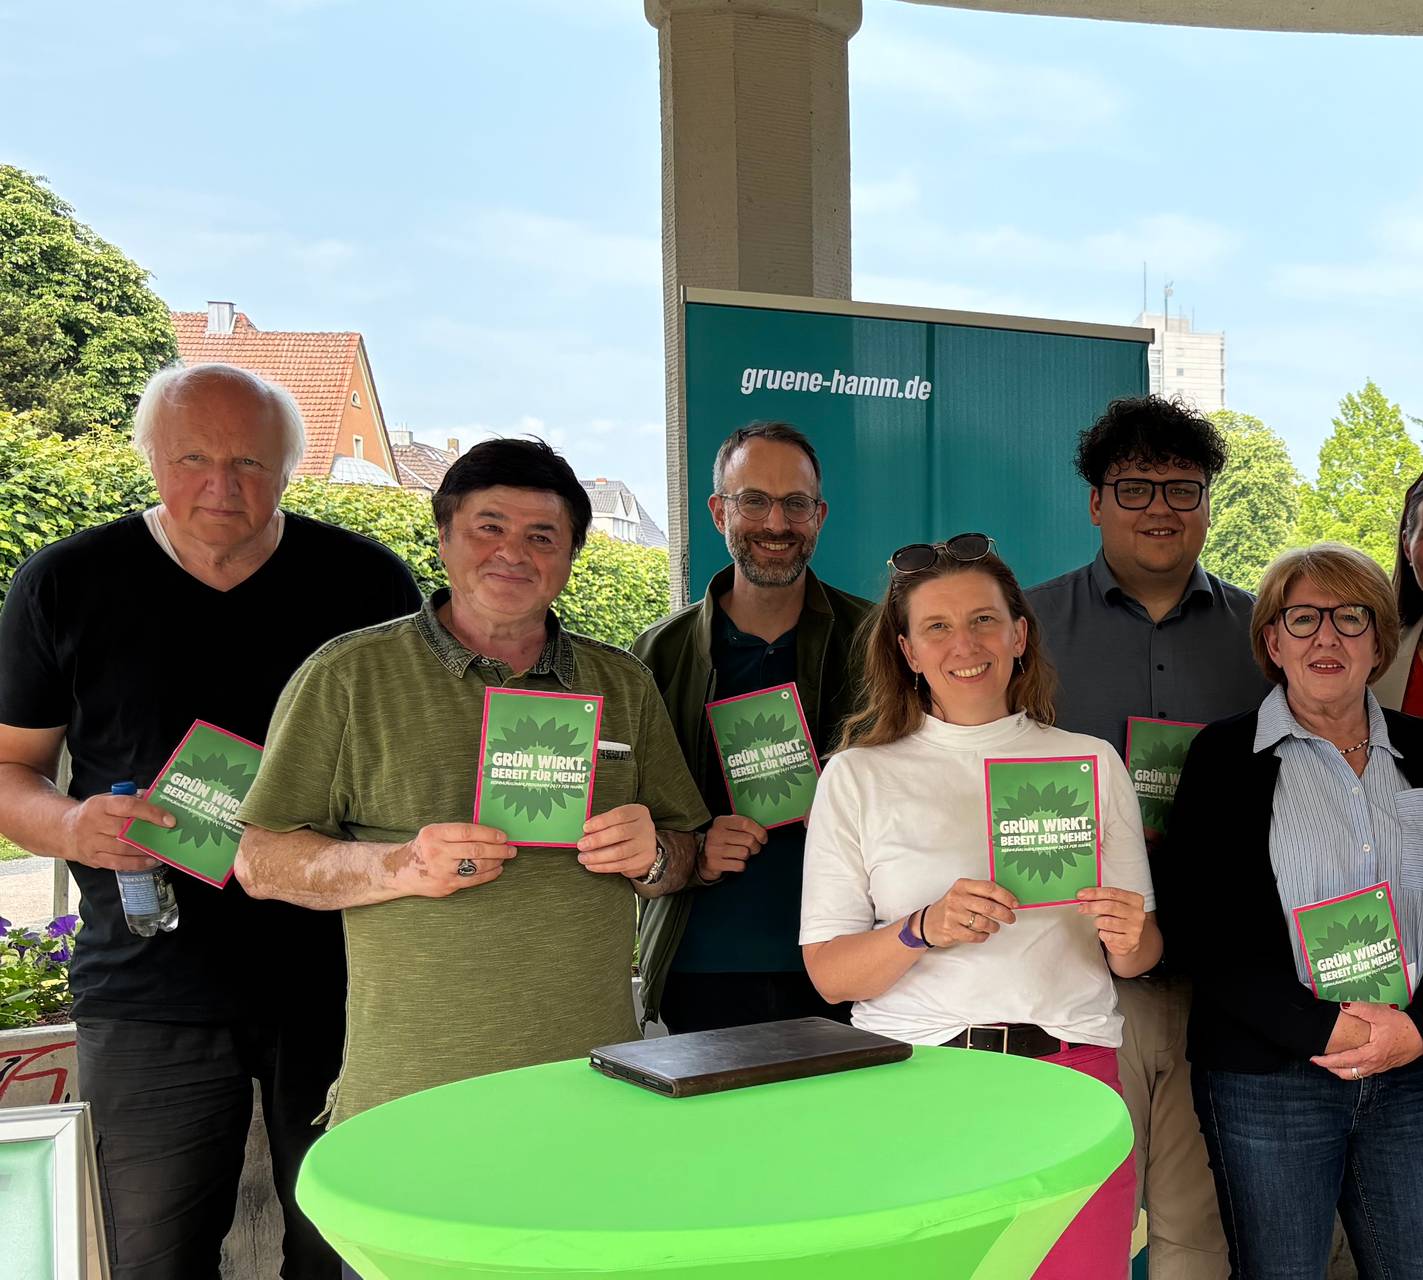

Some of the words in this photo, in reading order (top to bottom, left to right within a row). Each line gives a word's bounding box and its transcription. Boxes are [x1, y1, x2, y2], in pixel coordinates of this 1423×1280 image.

[740, 367, 932, 400] gruene-hamm.de
[492, 750, 534, 768] GRÜN
[537, 755, 587, 771] WIRKT.
[727, 748, 760, 768] GRÜN
[760, 738, 805, 760] WIRKT.
[730, 762, 760, 779] BEREIT
[760, 758, 779, 771] FÜR
[779, 751, 808, 767] MEHR!
[170, 772, 211, 800] GRÜN
[491, 768, 528, 780] BEREIT
[530, 768, 552, 781] FÜR
[553, 771, 586, 783] MEHR!
[1134, 768, 1167, 785] GRÜN
[1134, 782, 1163, 794] BEREIT
[1164, 785, 1178, 796] FÜ
[162, 783, 198, 807] BEREIT
[198, 797, 221, 818] FÜR
[1000, 817, 1039, 834] GRÜN
[1042, 816, 1092, 832] WIRKT.
[1000, 835, 1036, 847] BEREIT
[1038, 832, 1058, 845] FÜR
[1060, 831, 1092, 843] MEHR!
[1316, 952, 1352, 972] GRÜN
[1353, 938, 1396, 961] WIRKT.
[1319, 966, 1351, 983] BEREIT
[1352, 960, 1371, 974] FÜR
[1371, 950, 1398, 968] MEHR!
